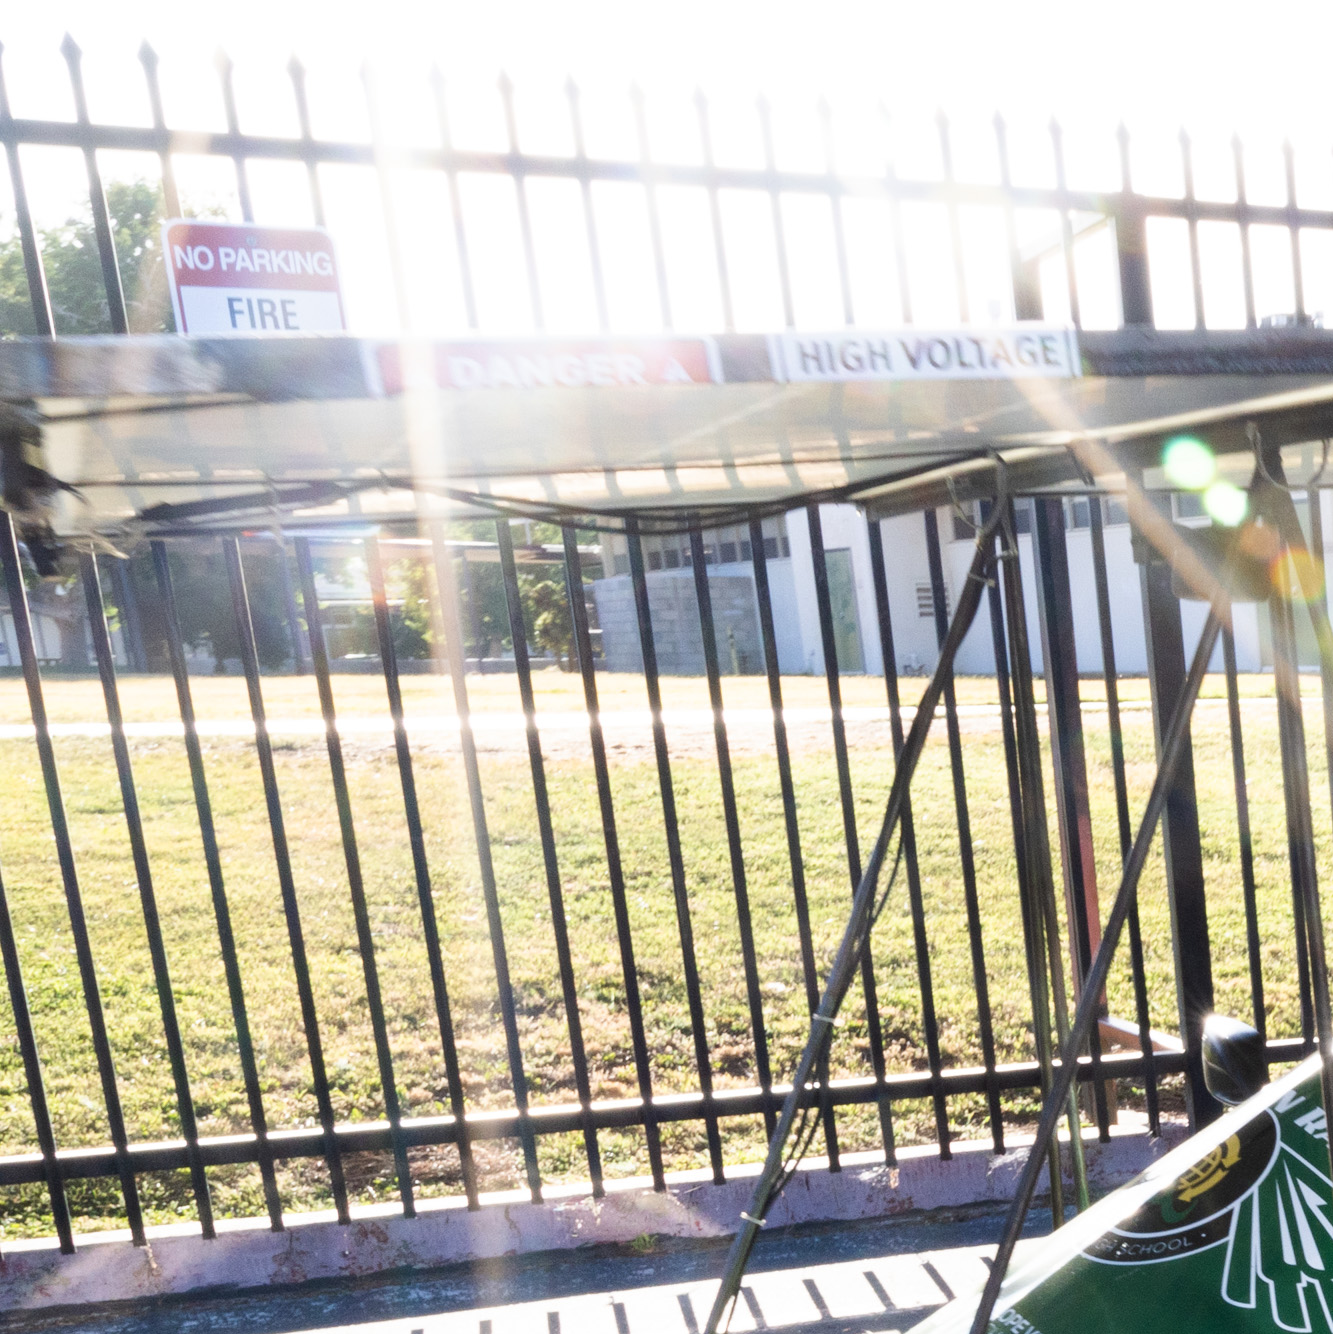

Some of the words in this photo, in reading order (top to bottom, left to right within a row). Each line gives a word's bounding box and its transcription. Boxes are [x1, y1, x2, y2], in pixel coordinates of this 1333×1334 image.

[173, 245, 215, 271] NO
[218, 246, 333, 276] PARKING
[227, 297, 300, 330] FIRE
[449, 352, 650, 388] DANGER
[797, 339, 895, 375] HIGH
[900, 334, 1061, 371] VOLTAGE
[1116, 1236, 1193, 1256] SCHOOL
